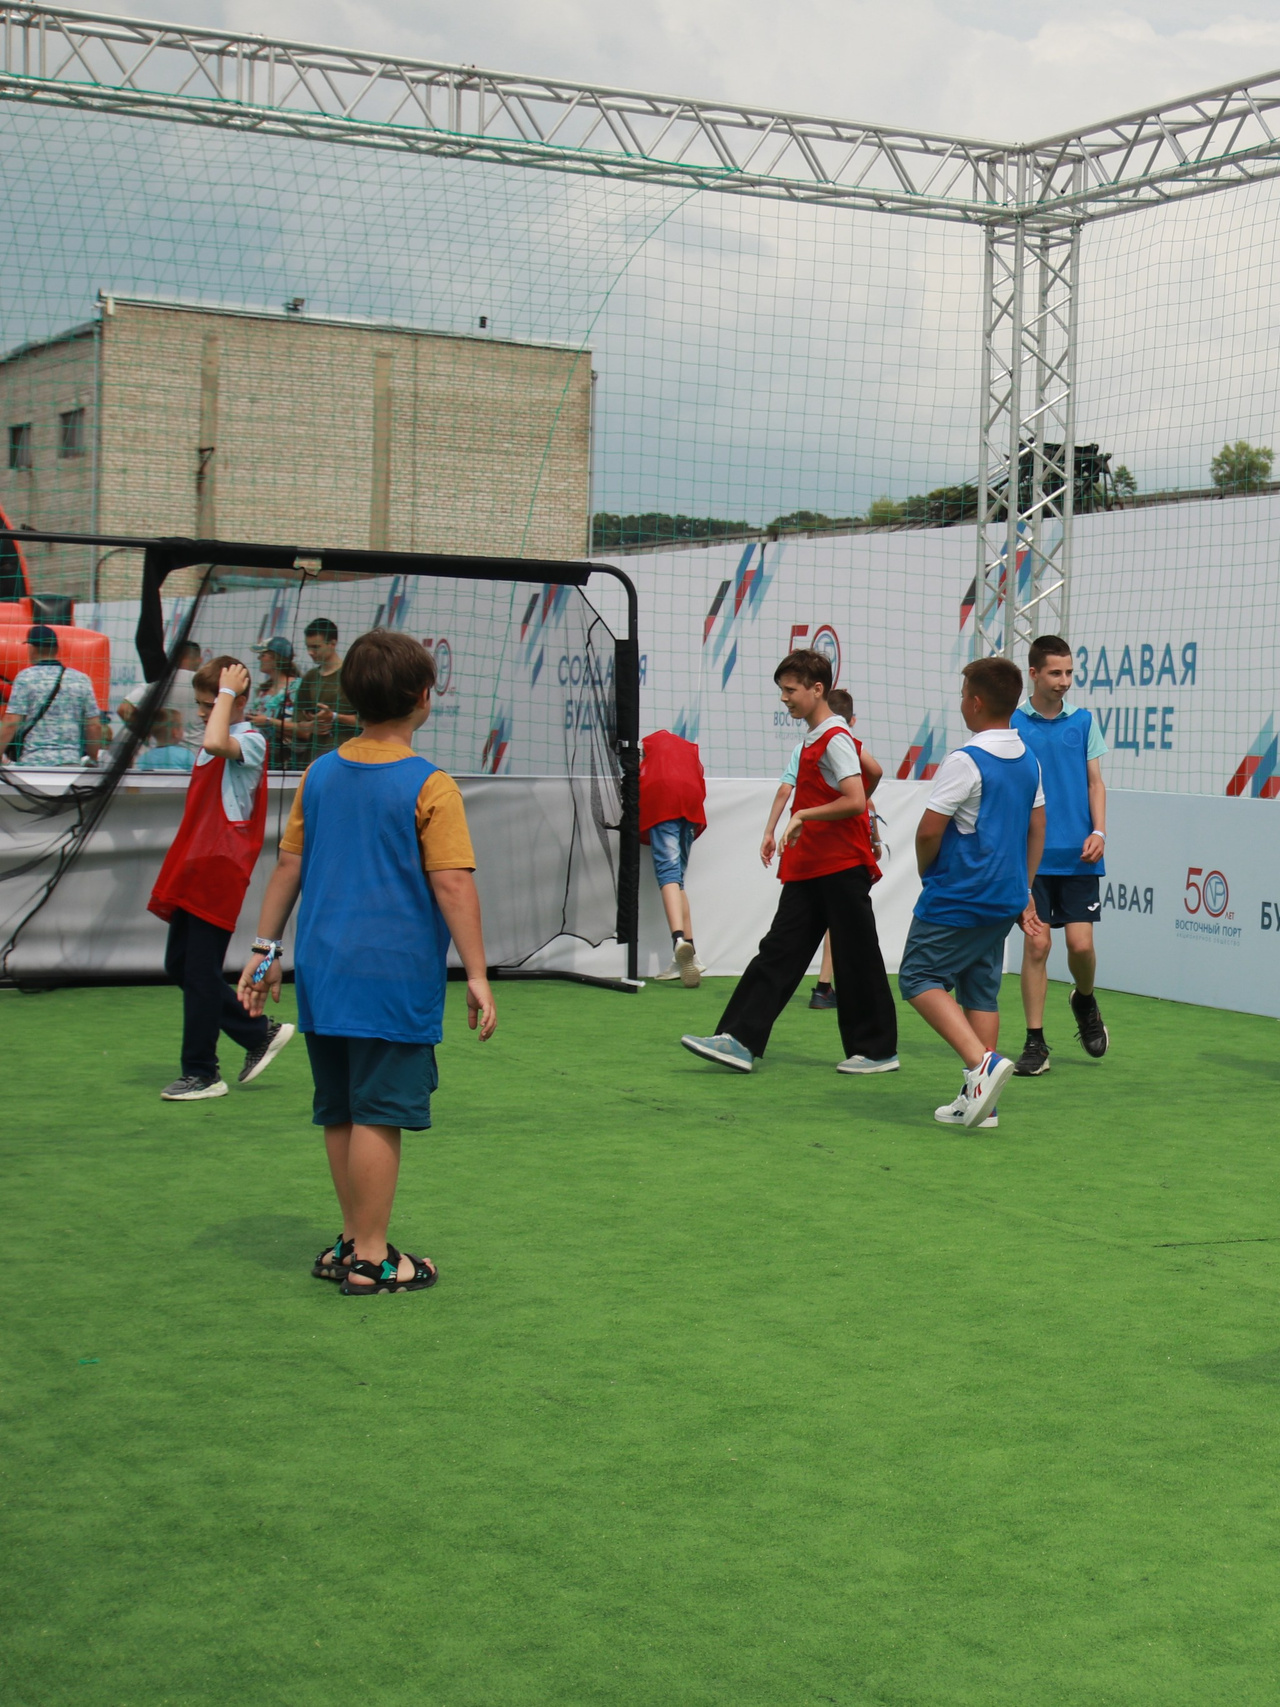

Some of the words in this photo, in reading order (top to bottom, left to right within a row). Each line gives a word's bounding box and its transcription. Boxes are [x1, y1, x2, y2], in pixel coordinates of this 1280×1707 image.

[558, 654, 647, 690] СОЗДАЯ
[1074, 642, 1197, 695] ЗДАВАЯ
[1096, 706, 1174, 757] УЩЕЕ
[1102, 882, 1154, 915] АВАЯ
[1184, 867, 1229, 918] 50
[1175, 919, 1220, 936] ВОСТОЧНЫЙ
[1222, 926, 1242, 938] ПОРТ
